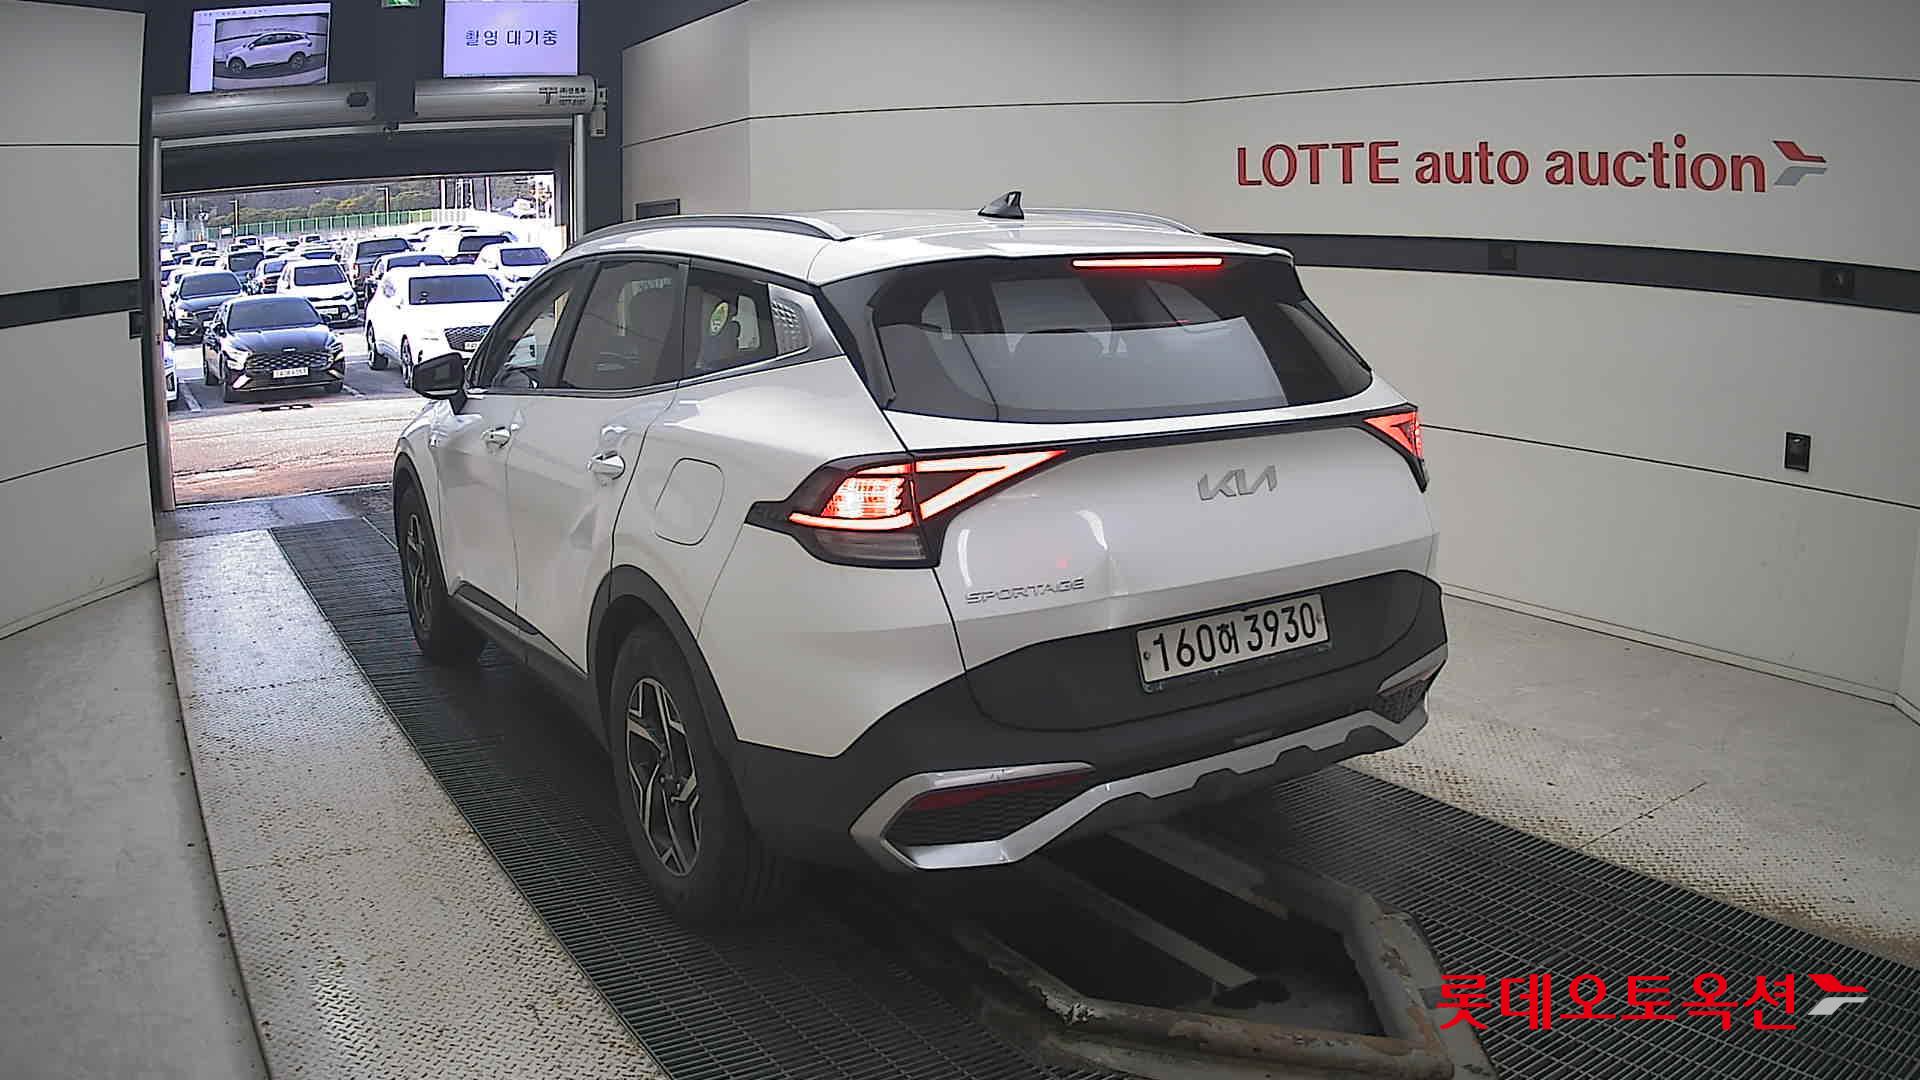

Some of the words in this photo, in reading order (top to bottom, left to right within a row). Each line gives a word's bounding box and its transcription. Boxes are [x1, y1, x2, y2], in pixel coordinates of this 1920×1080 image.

[506, 29, 558, 46] 대기중
[1237, 141, 1400, 187] LOTTE
[1415, 141, 1529, 185] auto
[1545, 134, 1766, 193] auction
[1197, 464, 1278, 501] KIA
[966, 578, 1086, 604] SPORTAGE
